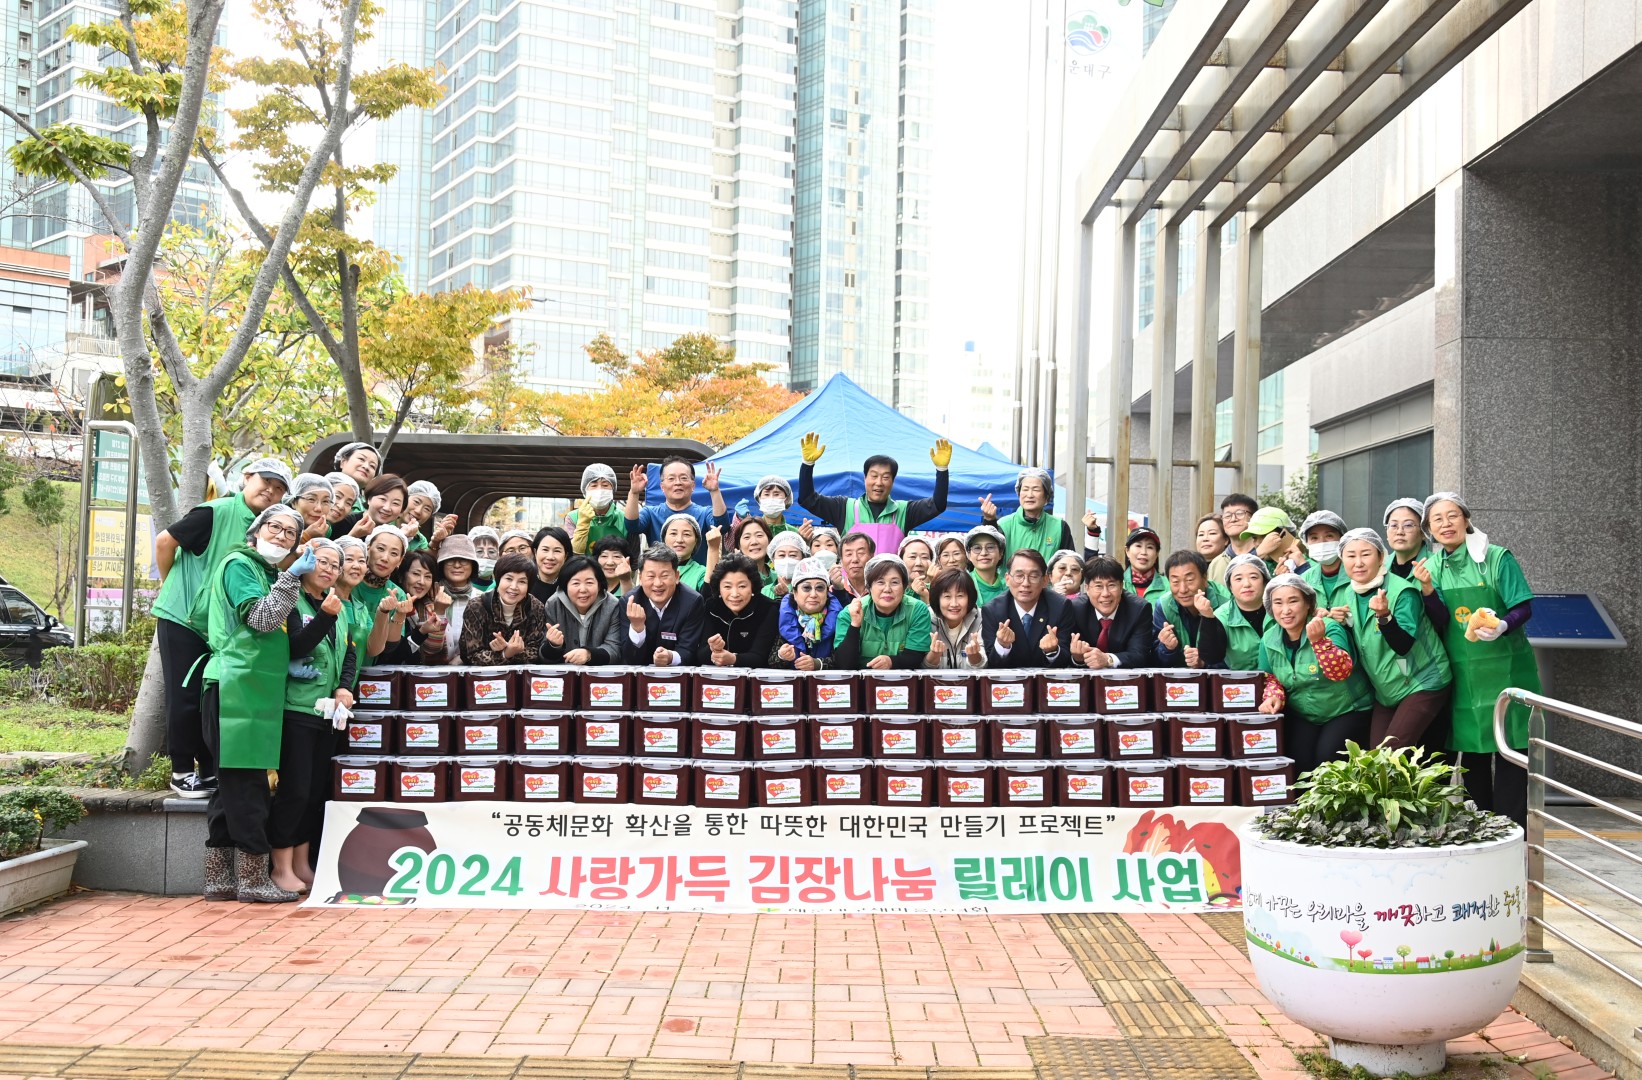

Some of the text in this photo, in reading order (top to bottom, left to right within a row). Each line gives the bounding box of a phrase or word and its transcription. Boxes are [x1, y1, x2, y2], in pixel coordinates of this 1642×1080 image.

[491, 812, 1116, 838] “공동체문화 확산을 통한 따뜻한 대한민국 만들기 프로젝트”
[390, 852, 1205, 903] 2024 사랑가득 김장나눔 릴레이 사업
[1265, 894, 1303, 918] 가꾸는
[1306, 900, 1370, 932] 우리마을
[1373, 902, 1447, 927] 깨끗하고
[1451, 894, 1501, 922] 쾌적한
